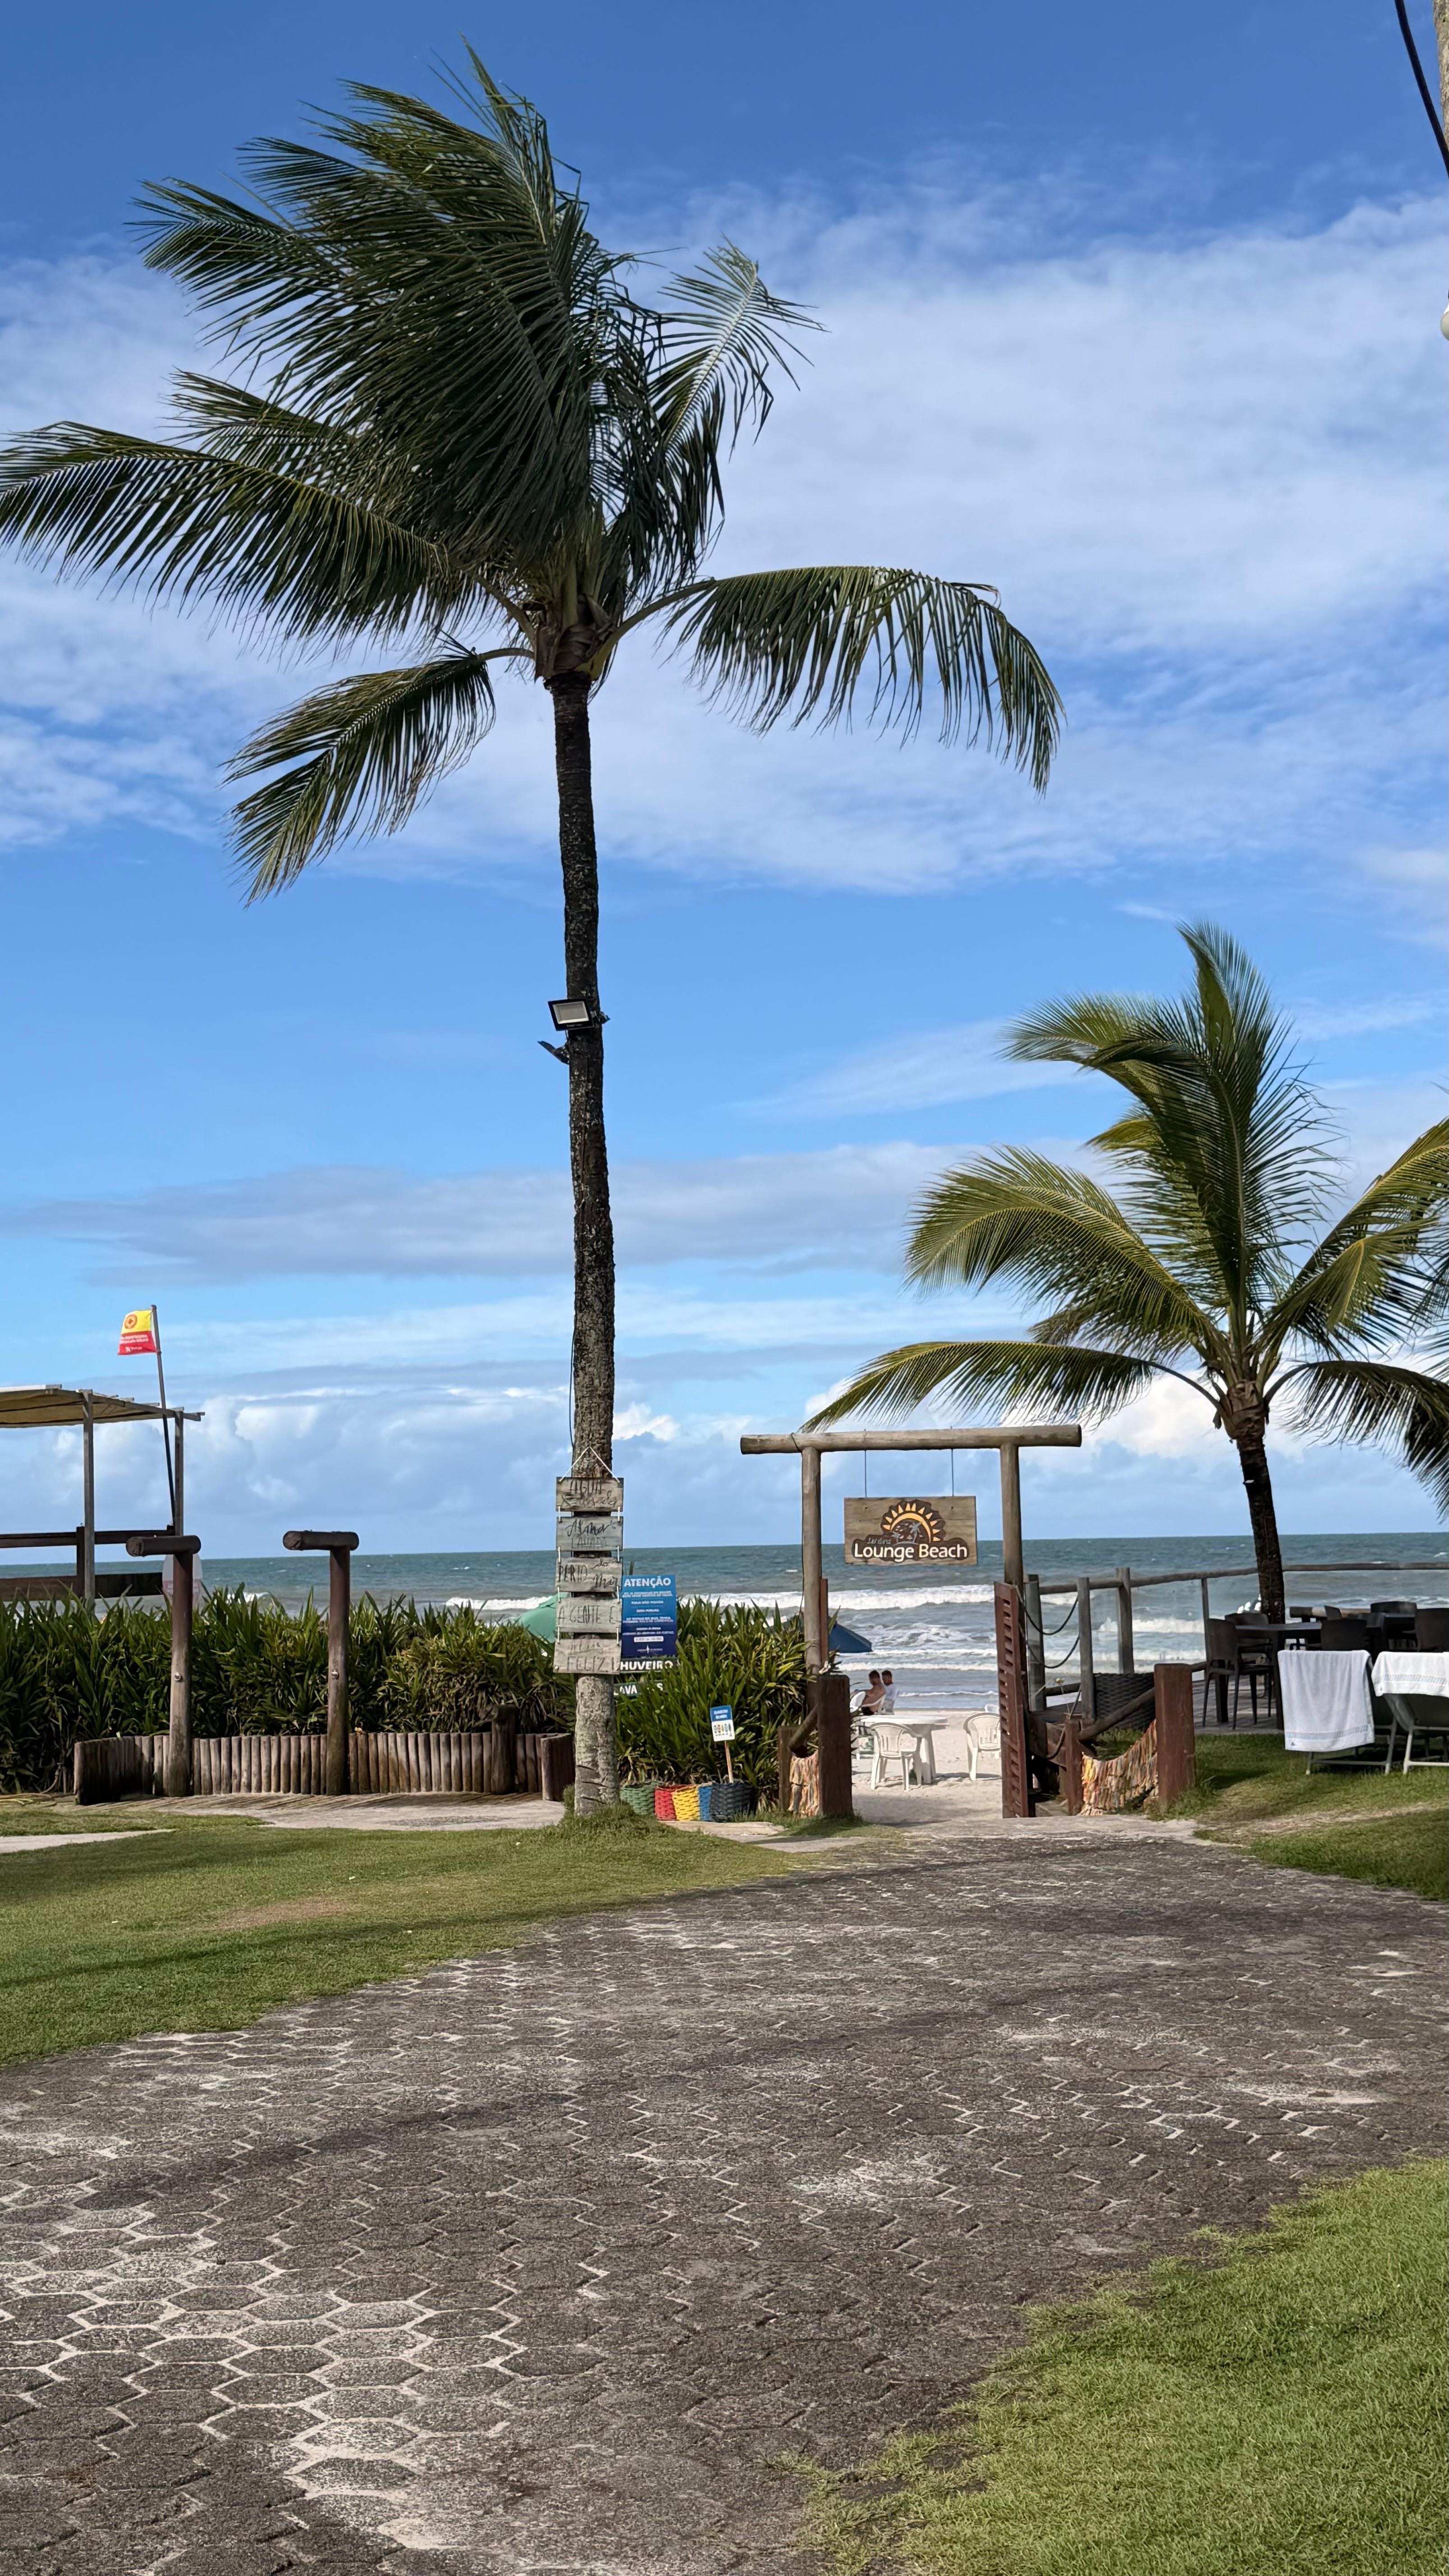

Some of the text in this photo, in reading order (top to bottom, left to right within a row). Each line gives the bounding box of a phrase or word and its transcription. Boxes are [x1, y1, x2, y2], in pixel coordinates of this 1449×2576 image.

[855, 1543, 967, 1562] Lounge Beach
[624, 1576, 671, 1588] ATENÇÃO
[570, 1605, 602, 1624] GENTE
[619, 1660, 673, 1670] HUVEIRO
